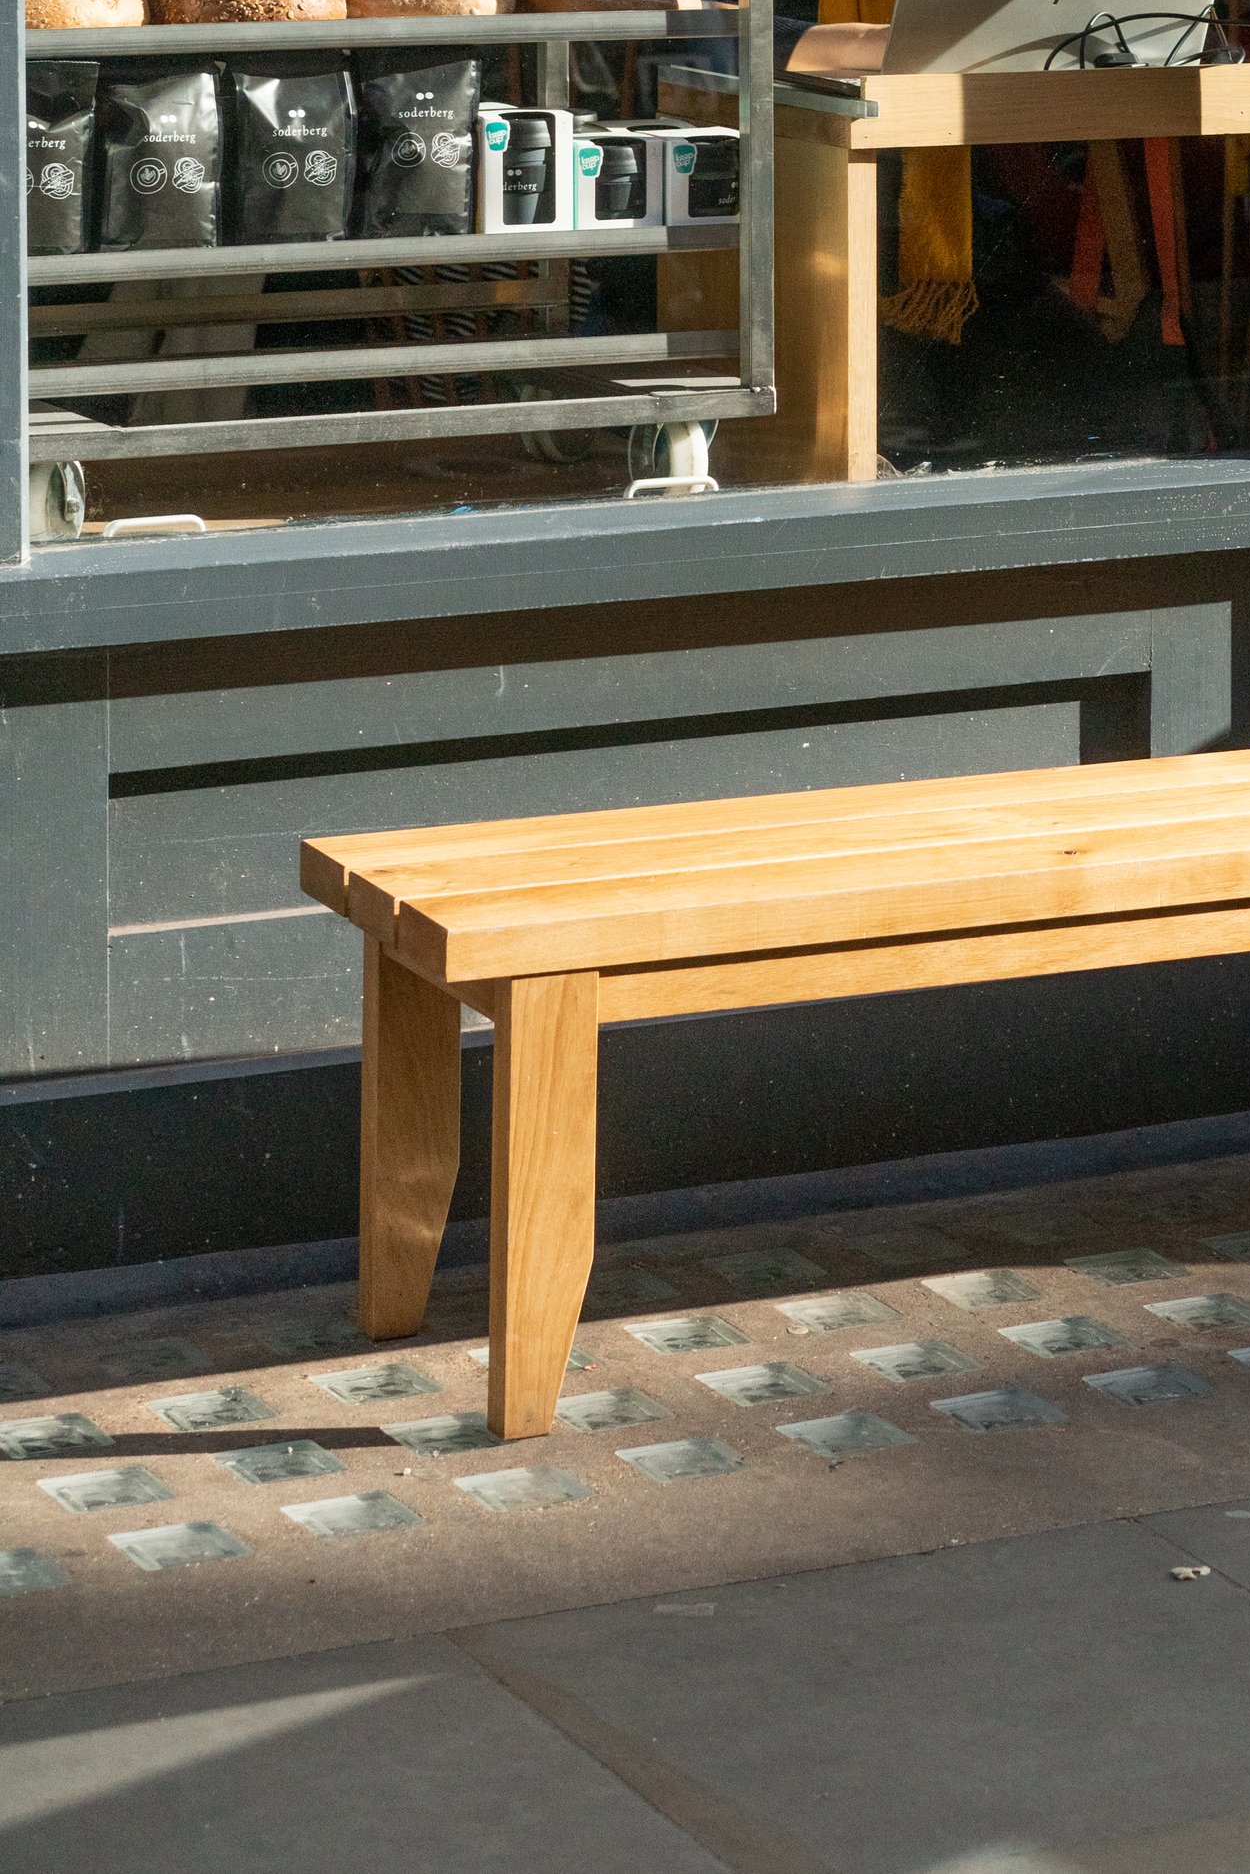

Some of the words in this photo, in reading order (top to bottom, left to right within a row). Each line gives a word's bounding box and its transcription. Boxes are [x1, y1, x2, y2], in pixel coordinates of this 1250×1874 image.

[398, 107, 454, 119] soderberg
[272, 125, 328, 138] soderberg
[143, 133, 196, 144] soderberg
